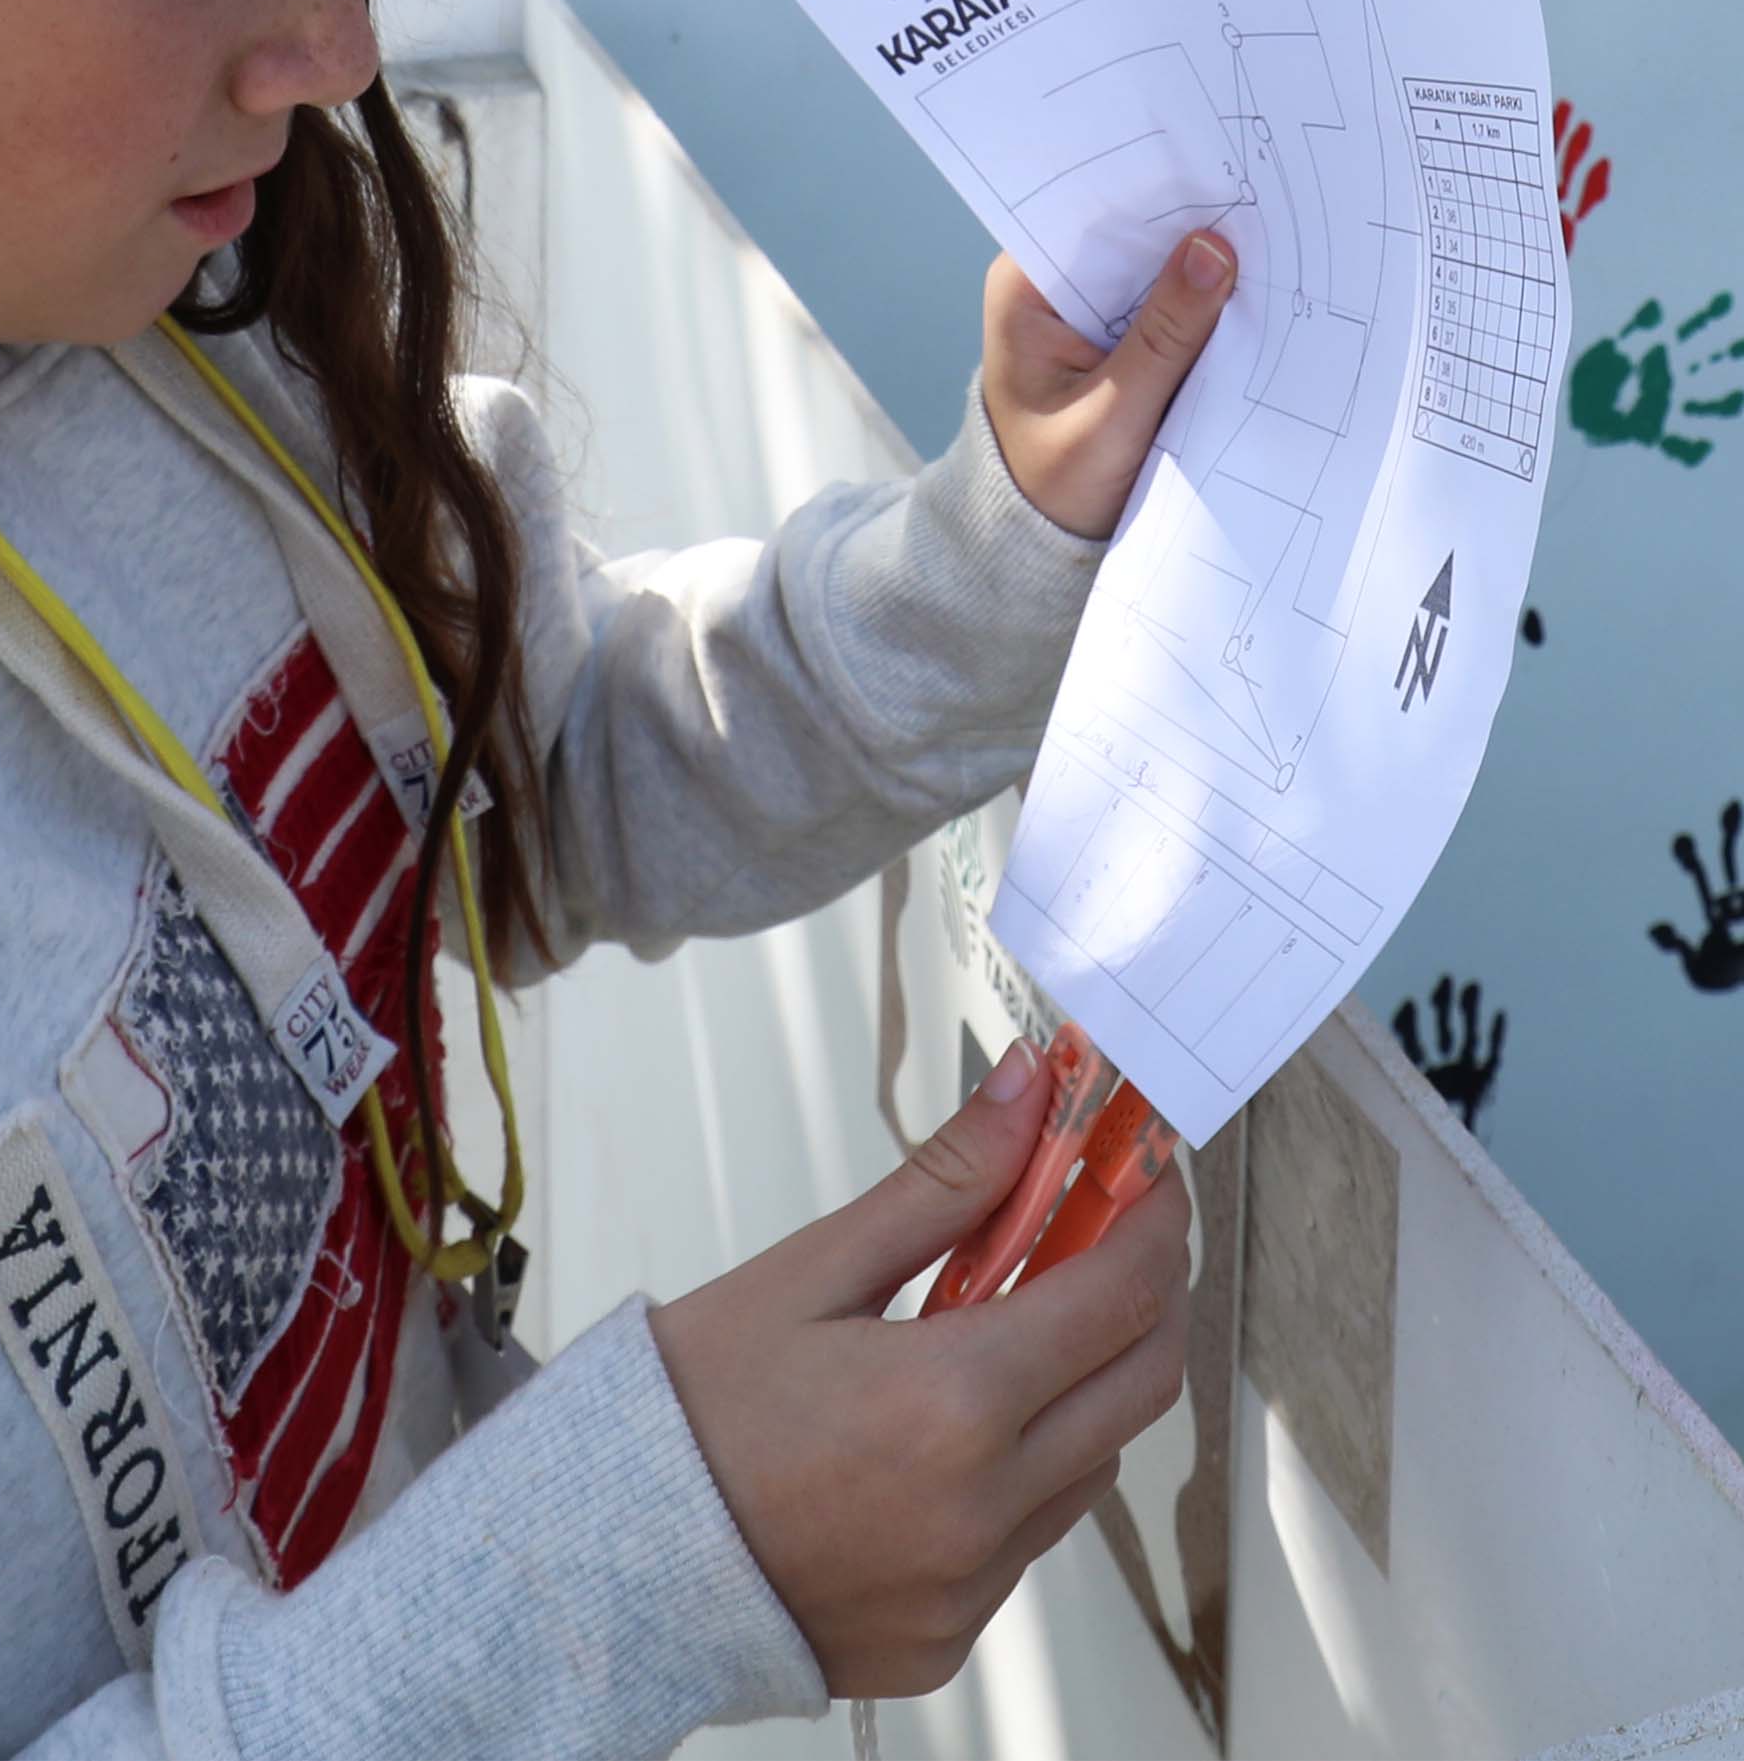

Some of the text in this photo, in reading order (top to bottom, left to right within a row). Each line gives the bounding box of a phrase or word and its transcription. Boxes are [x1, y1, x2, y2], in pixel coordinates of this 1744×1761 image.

[933, 4, 1037, 75] BELEDİYESİ
[1415, 87, 1523, 111] KARATAY TABİAT PARKI
[1434, 118, 1442, 131] A
[1487, 125, 1501, 139] km
[1428, 176, 1434, 190] 1
[1433, 205, 1440, 220] 2
[1436, 235, 1442, 250] 3
[1435, 265, 1442, 280] 4
[1434, 296, 1441, 311] 5
[1432, 326, 1438, 341] 6
[1429, 356, 1436, 371] 7
[1423, 386, 1431, 402] 8
[390, 742, 433, 772] CIT
[285, 975, 333, 1038] CITY
[300, 1004, 356, 1076] 75
